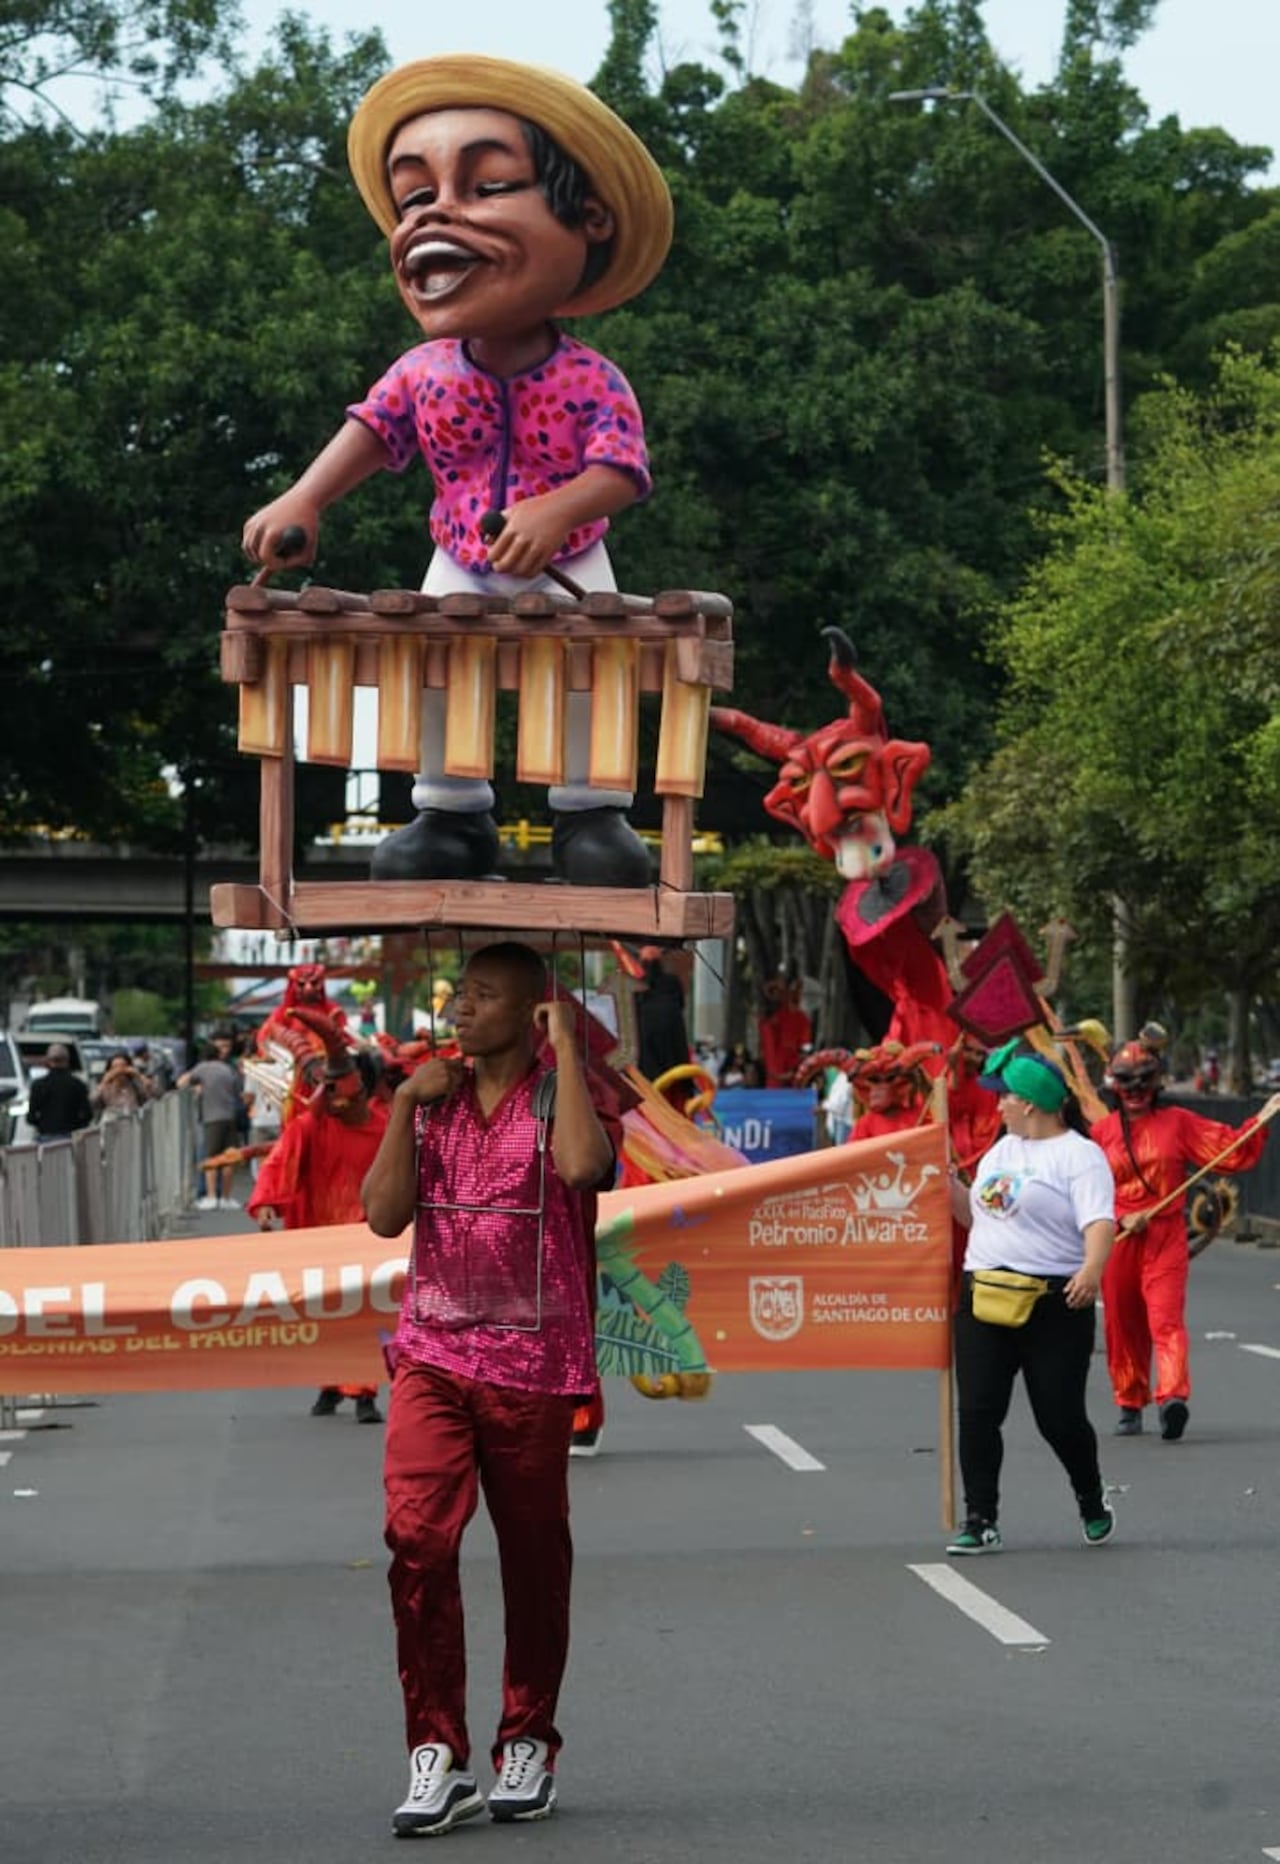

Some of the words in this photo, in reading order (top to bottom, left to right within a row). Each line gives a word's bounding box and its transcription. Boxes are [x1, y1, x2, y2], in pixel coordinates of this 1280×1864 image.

[749, 1220, 837, 1247] Petronio
[170, 1257, 413, 1331] CAUC
[872, 1292, 888, 1304] DE
[813, 1307, 889, 1323] SANTIAGO
[891, 1307, 912, 1322] DE
[914, 1306, 948, 1322] CALI
[125, 1334, 181, 1352] DEL
